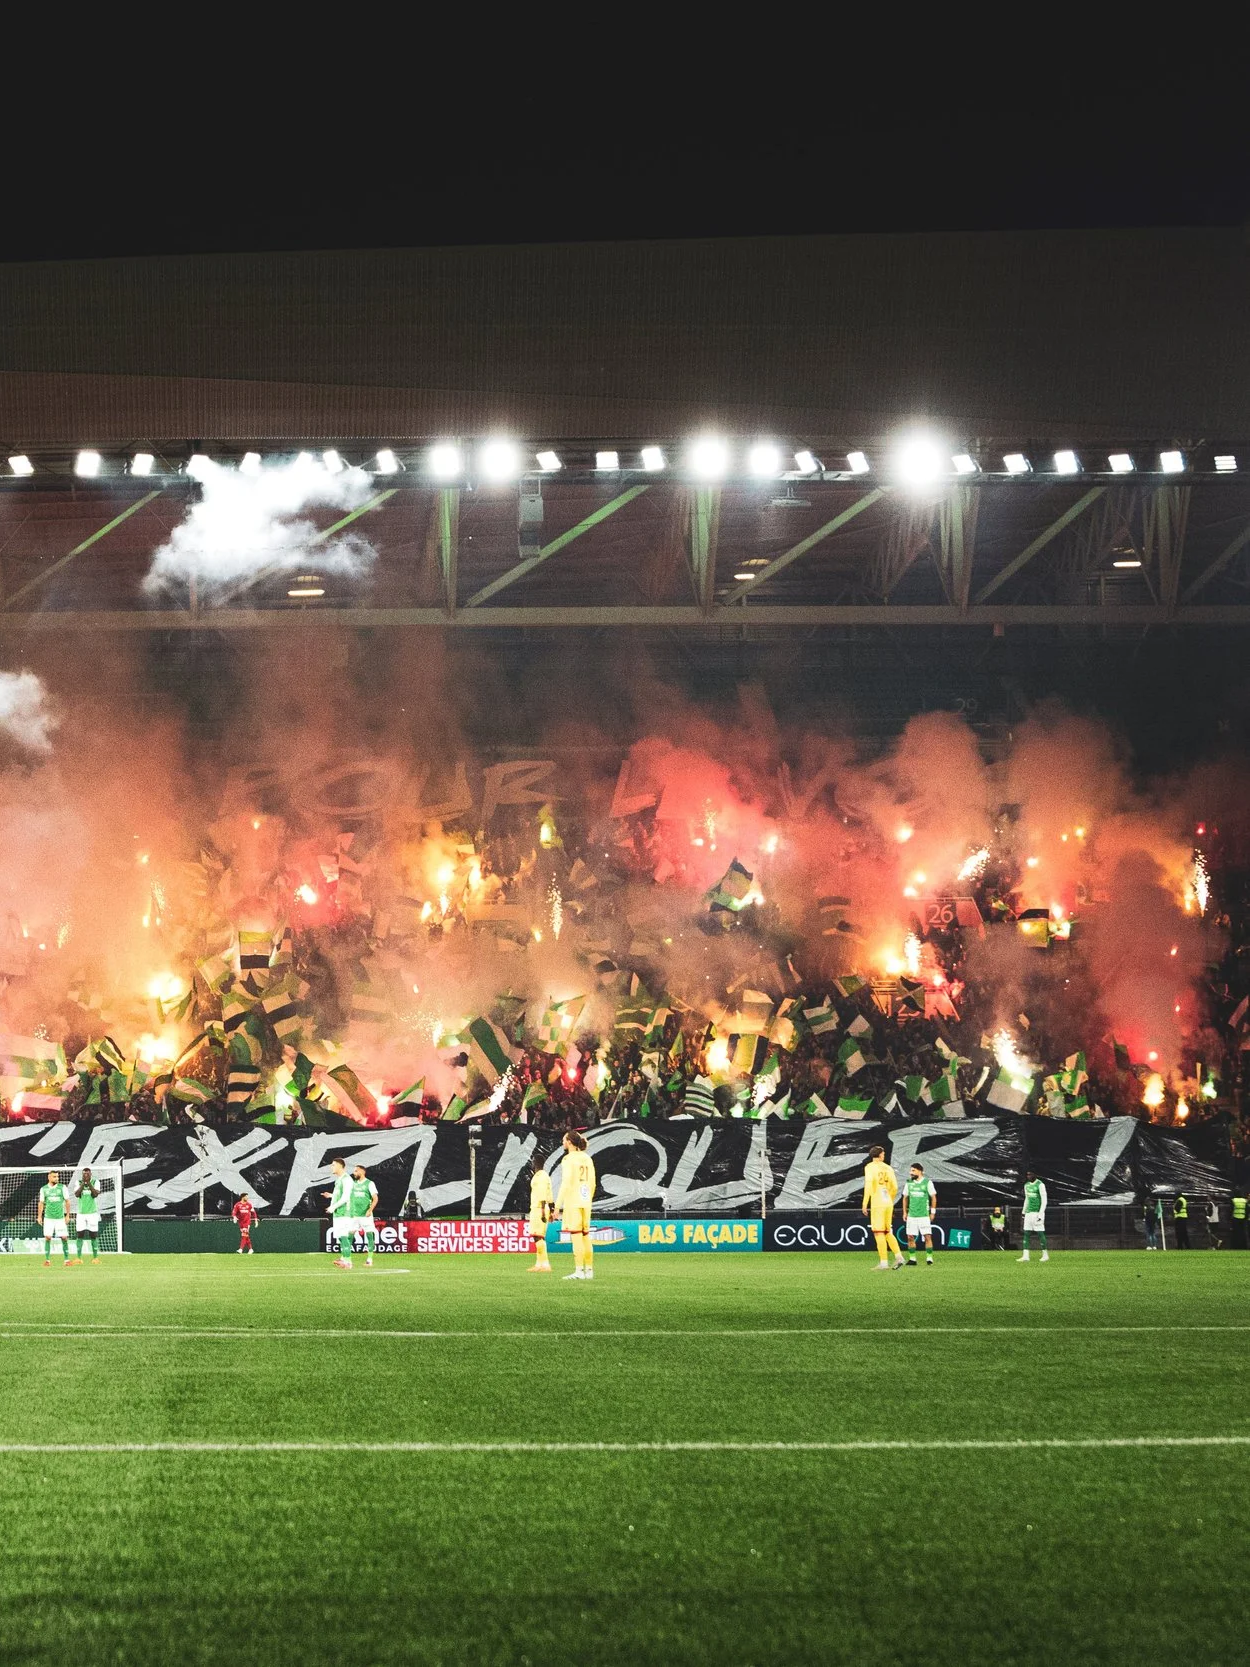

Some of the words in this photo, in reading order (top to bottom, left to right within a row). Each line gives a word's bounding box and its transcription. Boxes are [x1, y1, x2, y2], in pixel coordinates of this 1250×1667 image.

[928, 904, 954, 924] 26
[578, 1165, 589, 1182] 21
[429, 1222, 518, 1237] SOLUTIONS
[638, 1224, 677, 1244] BAS
[683, 1224, 759, 1249] FAÇADE
[326, 1244, 408, 1252] ECAFADAGE
[417, 1237, 493, 1252] SERVICES
